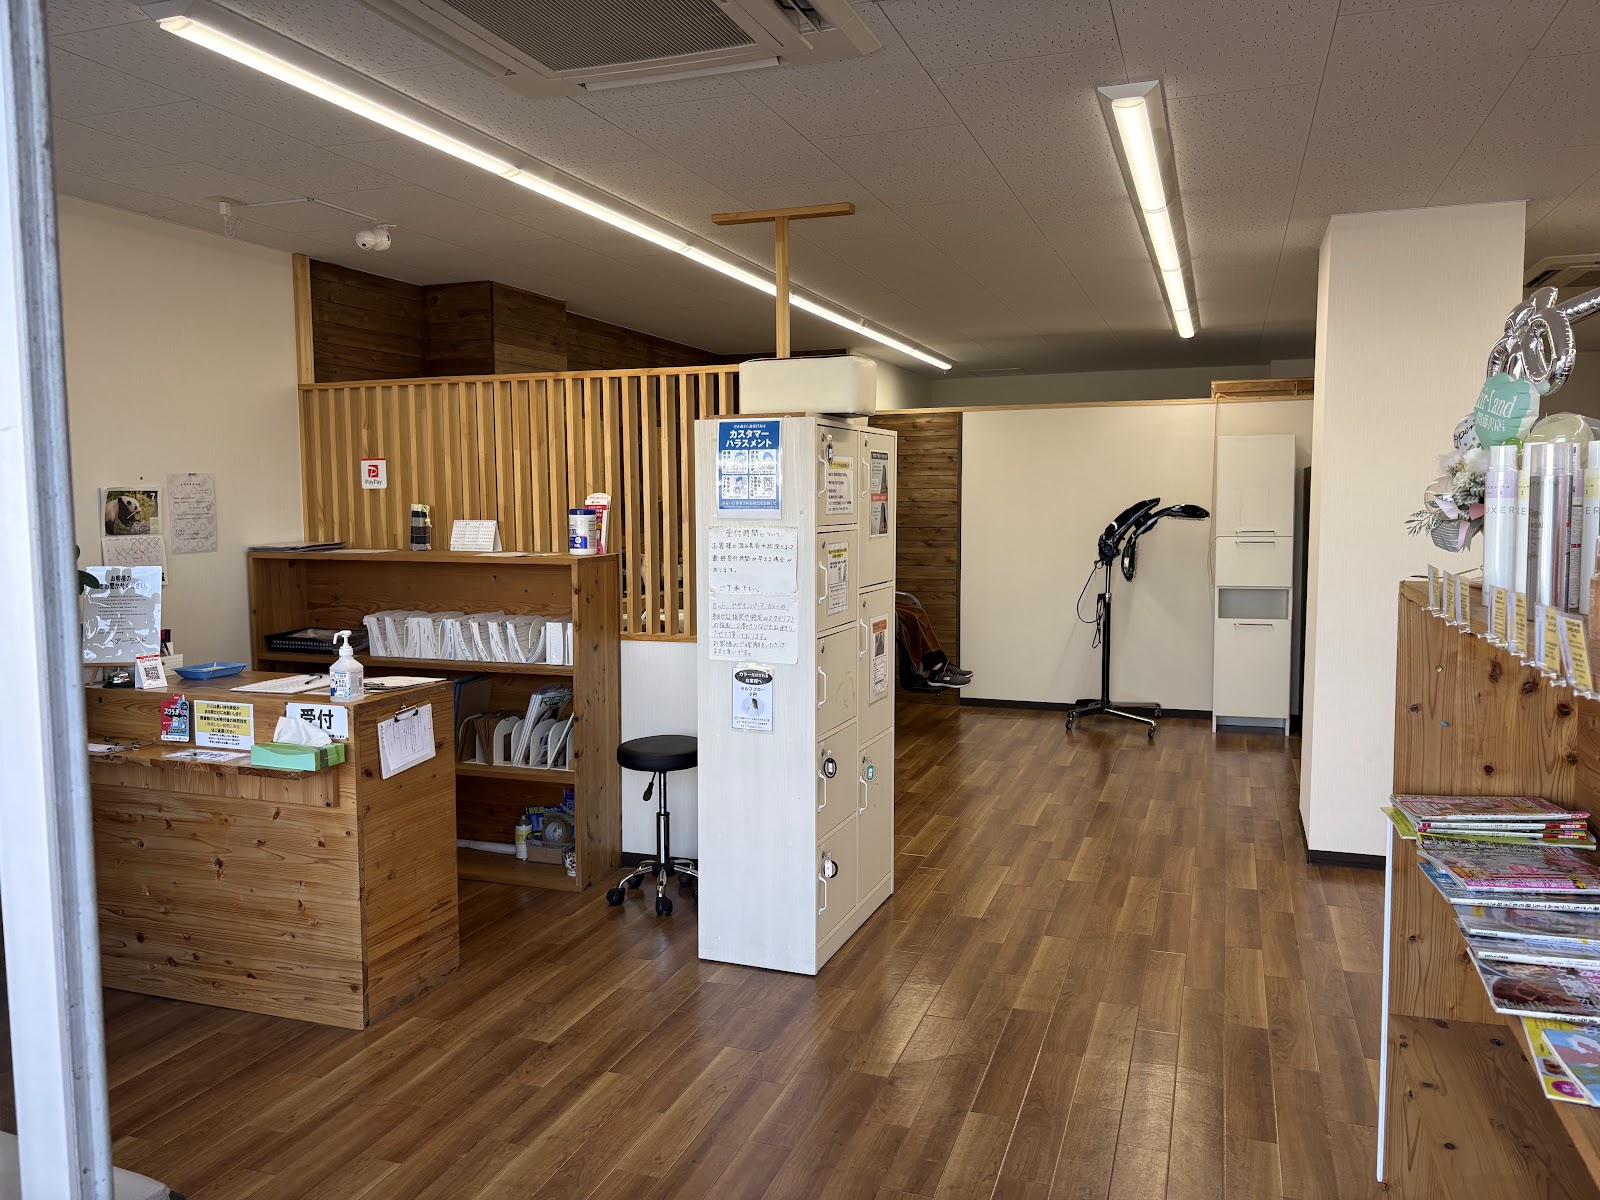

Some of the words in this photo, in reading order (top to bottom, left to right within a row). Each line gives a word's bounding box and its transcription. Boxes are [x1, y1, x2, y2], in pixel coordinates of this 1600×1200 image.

[729, 430, 769, 438] カスタマー
[726, 439, 772, 448] ハラスメント
[300, 709, 334, 730] 受付
